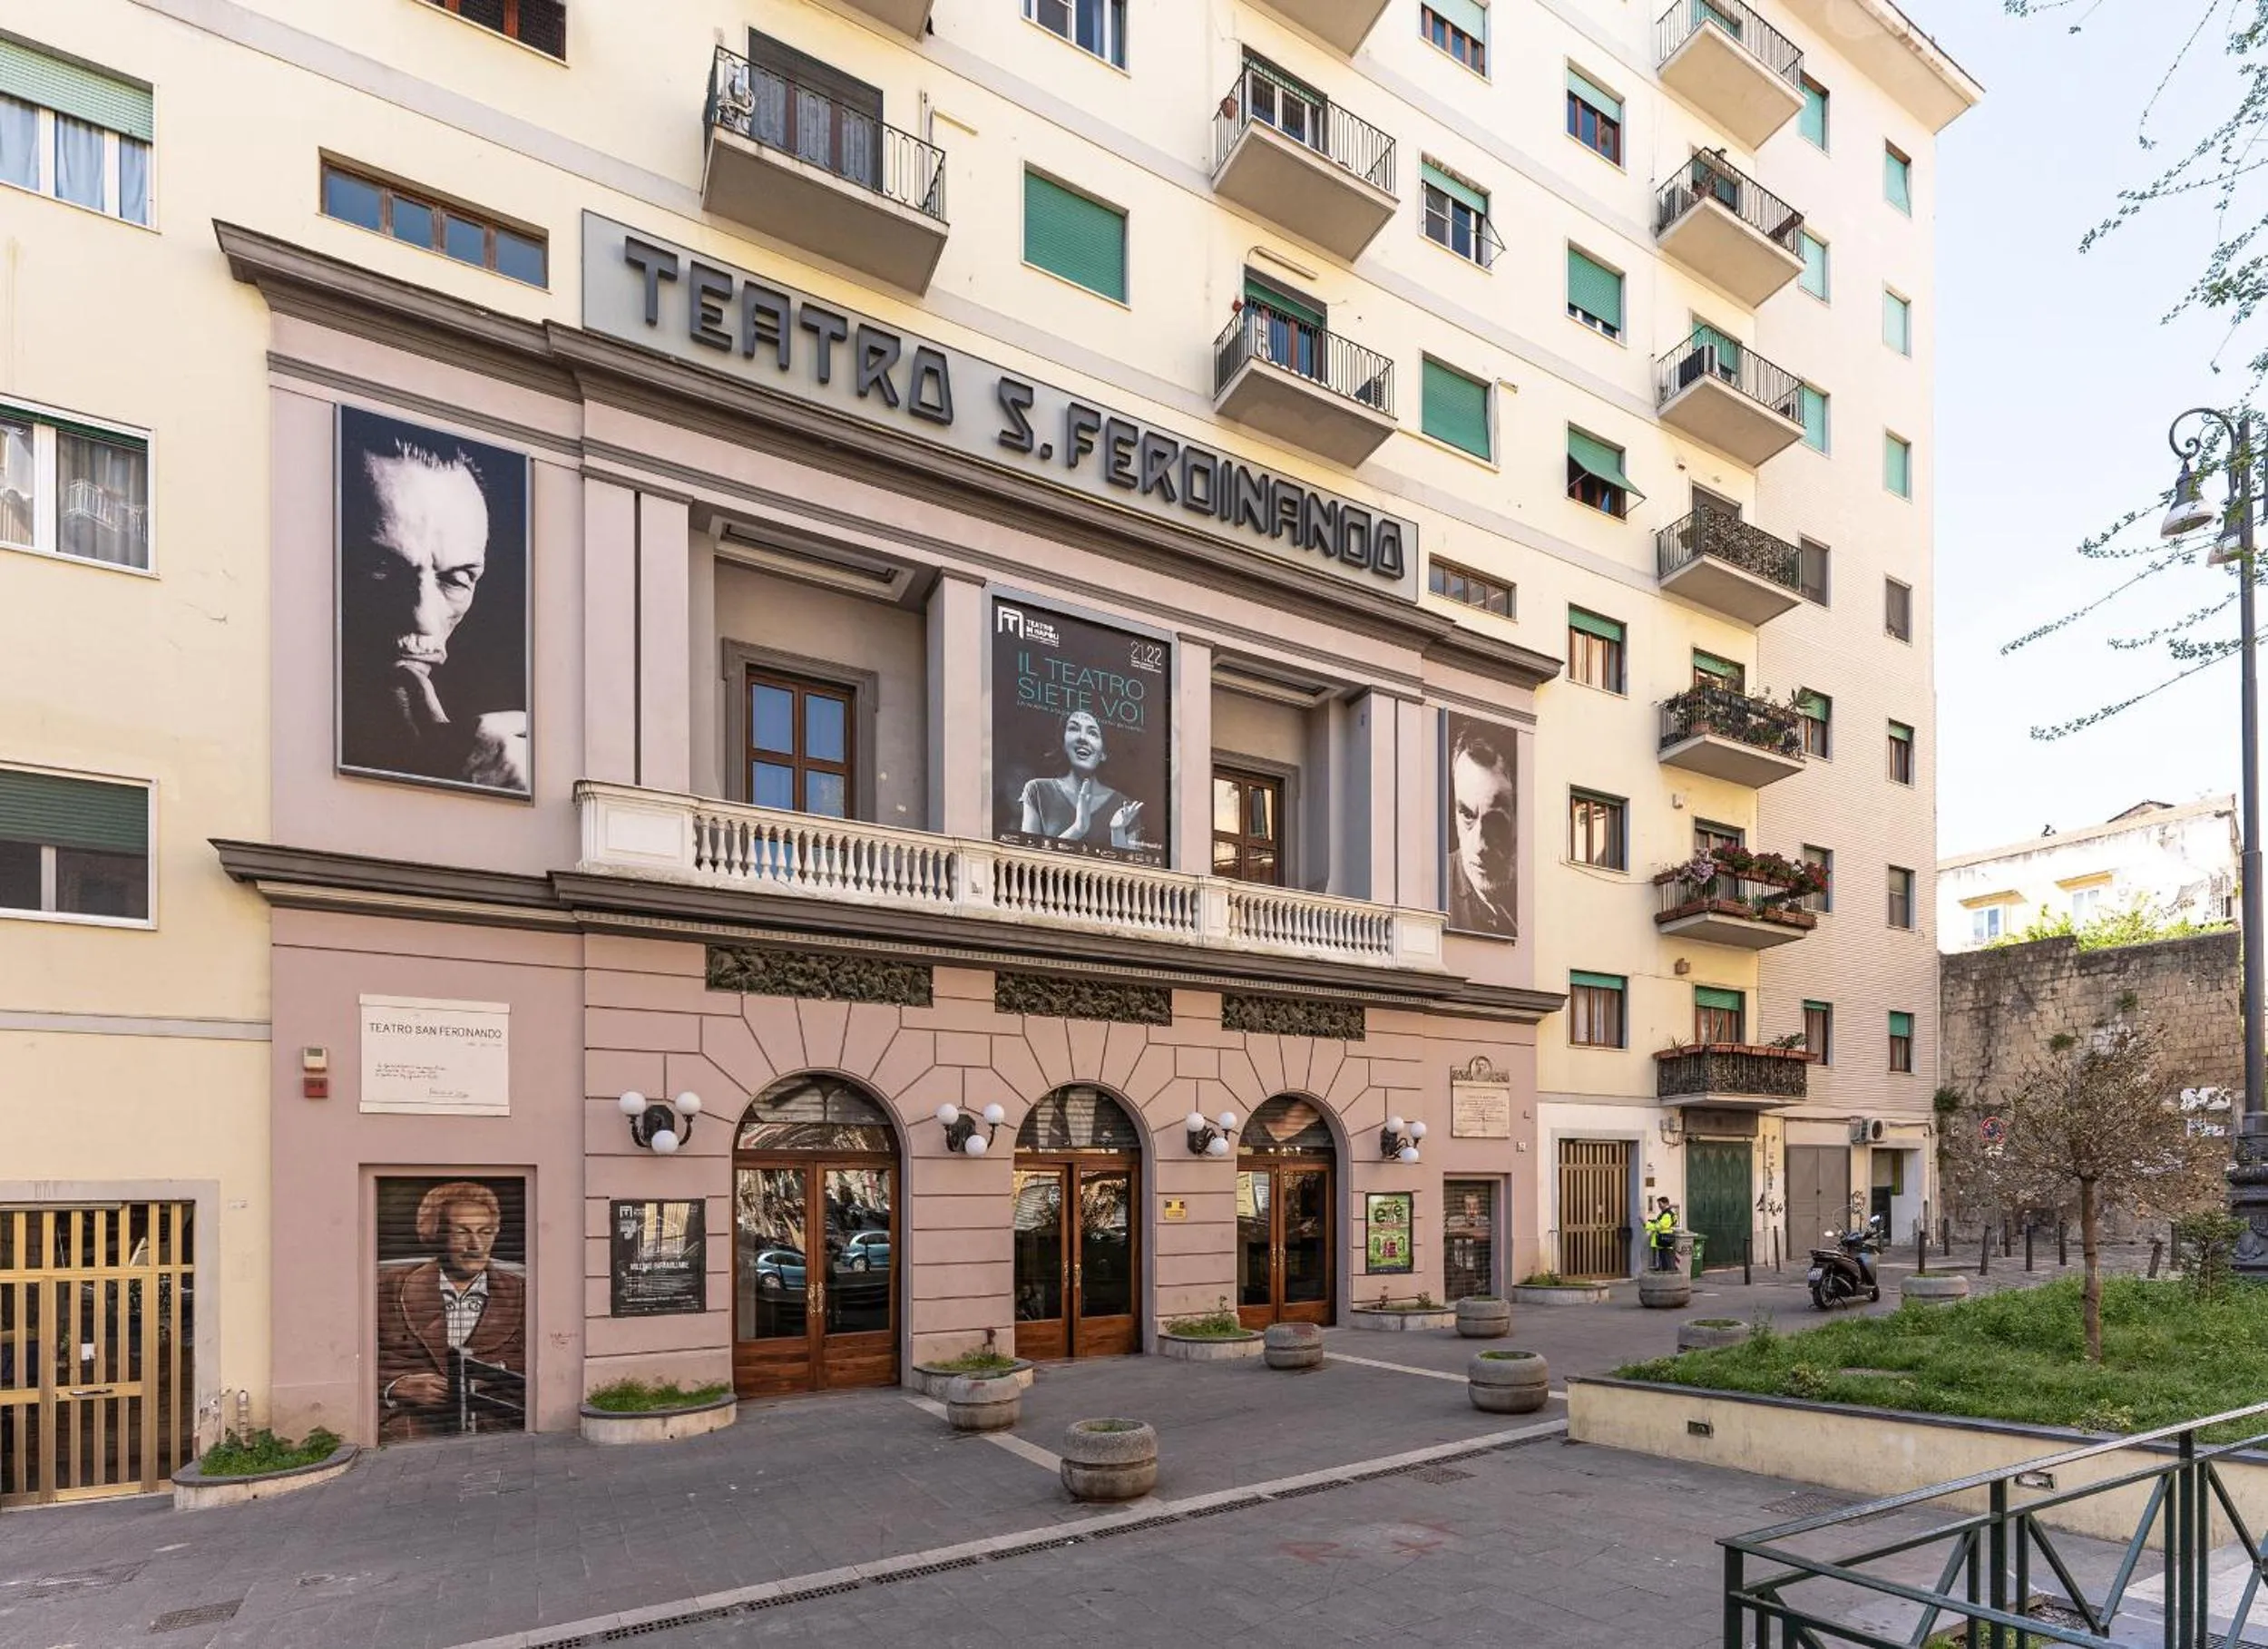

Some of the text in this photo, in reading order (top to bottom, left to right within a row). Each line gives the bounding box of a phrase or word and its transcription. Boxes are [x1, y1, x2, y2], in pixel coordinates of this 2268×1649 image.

[624, 235, 954, 426] TEATRO
[1018, 651, 1039, 677] IL
[1044, 658, 1145, 701] TEATRO
[1130, 640, 1162, 666] 21.22
[1018, 677, 1092, 713] SIETE
[1100, 696, 1145, 727] VOI
[369, 1022, 413, 1034] TEATRO
[415, 1025, 436, 1035] SAN
